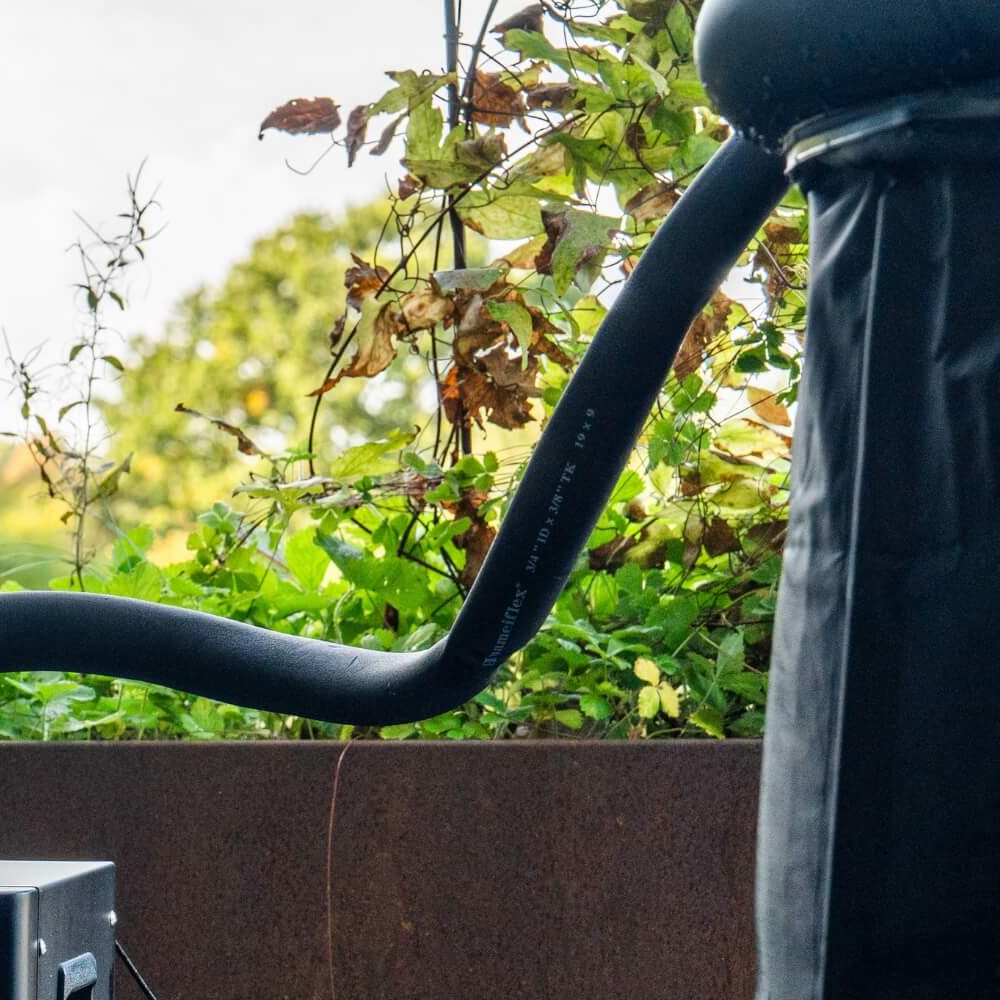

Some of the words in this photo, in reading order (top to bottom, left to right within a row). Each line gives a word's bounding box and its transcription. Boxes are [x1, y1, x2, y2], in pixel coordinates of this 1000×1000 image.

[586, 408, 595, 417] 9
[583, 422, 592, 431] x
[574, 433, 587, 449] 19
[560, 462, 576, 482] TK
